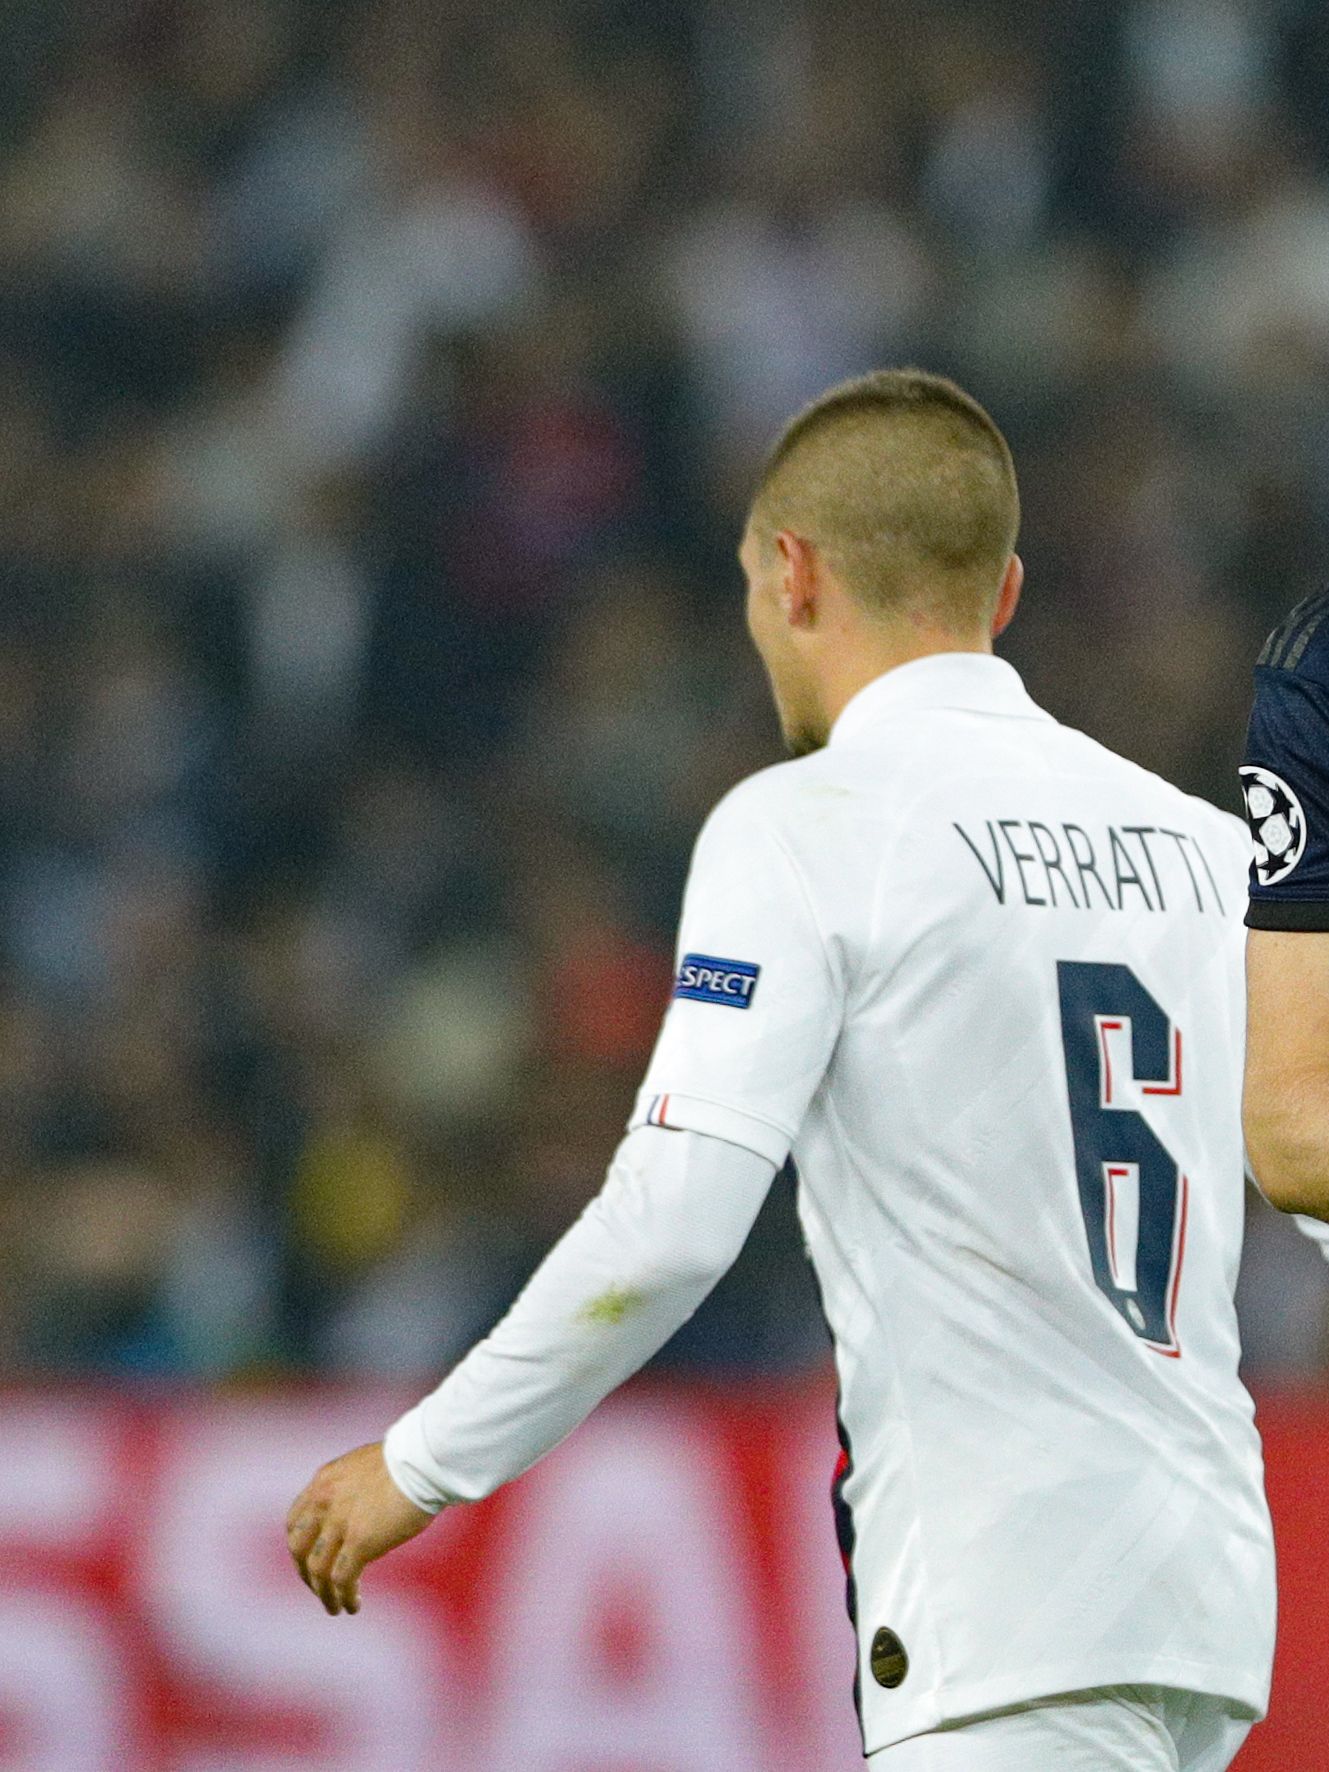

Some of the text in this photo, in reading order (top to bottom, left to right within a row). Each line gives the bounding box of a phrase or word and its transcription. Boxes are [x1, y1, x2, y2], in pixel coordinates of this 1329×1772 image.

[953, 820, 1226, 917] VERRATTI
[679, 965, 756, 996] SPECT
[1056, 960, 1188, 1358] 6
